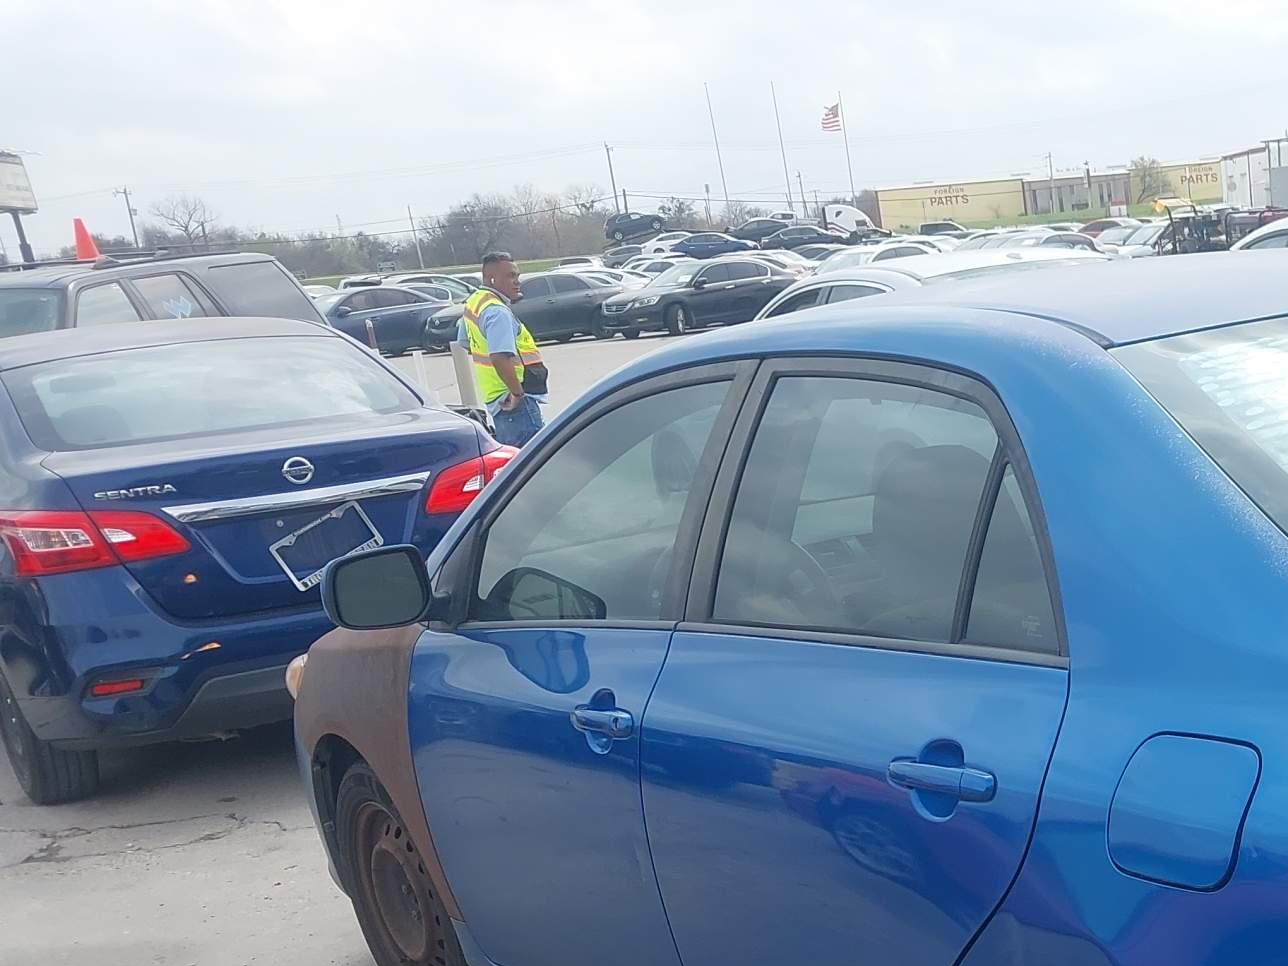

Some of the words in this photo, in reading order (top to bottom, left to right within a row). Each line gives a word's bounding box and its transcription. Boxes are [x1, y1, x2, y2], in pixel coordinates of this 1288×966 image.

[1180, 173, 1218, 184] PARTS
[930, 194, 969, 206] PARTS
[94, 484, 177, 500] SENTRA
